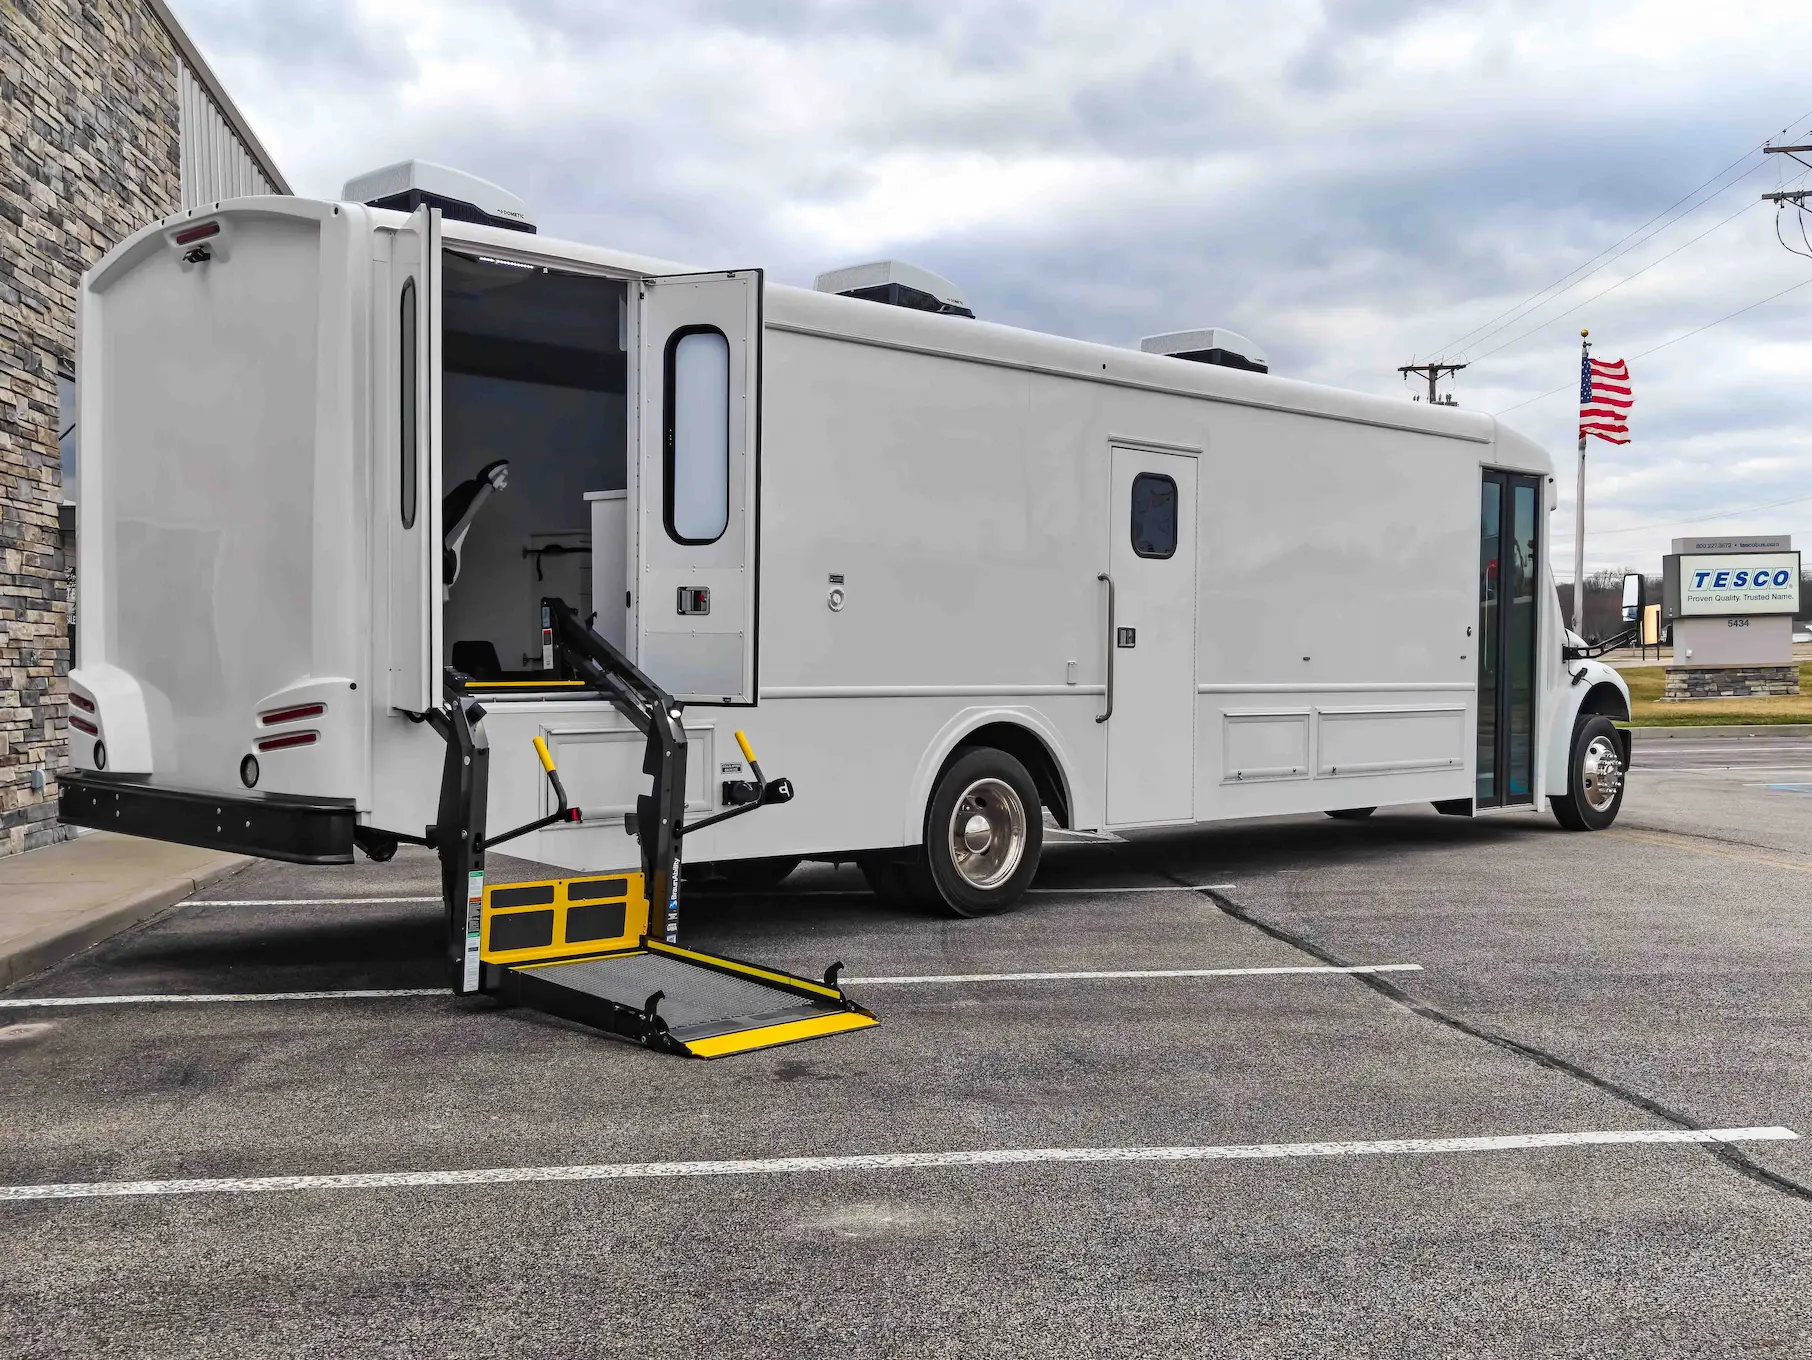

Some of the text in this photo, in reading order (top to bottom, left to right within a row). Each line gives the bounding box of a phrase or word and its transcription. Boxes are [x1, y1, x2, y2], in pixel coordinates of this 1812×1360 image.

[1695, 570, 1789, 588] TESCO
[1714, 594, 1741, 602] Quality.
[1743, 593, 1770, 601] Trusted
[1727, 619, 1750, 627] 5434
[671, 858, 681, 899] BraunAbility
